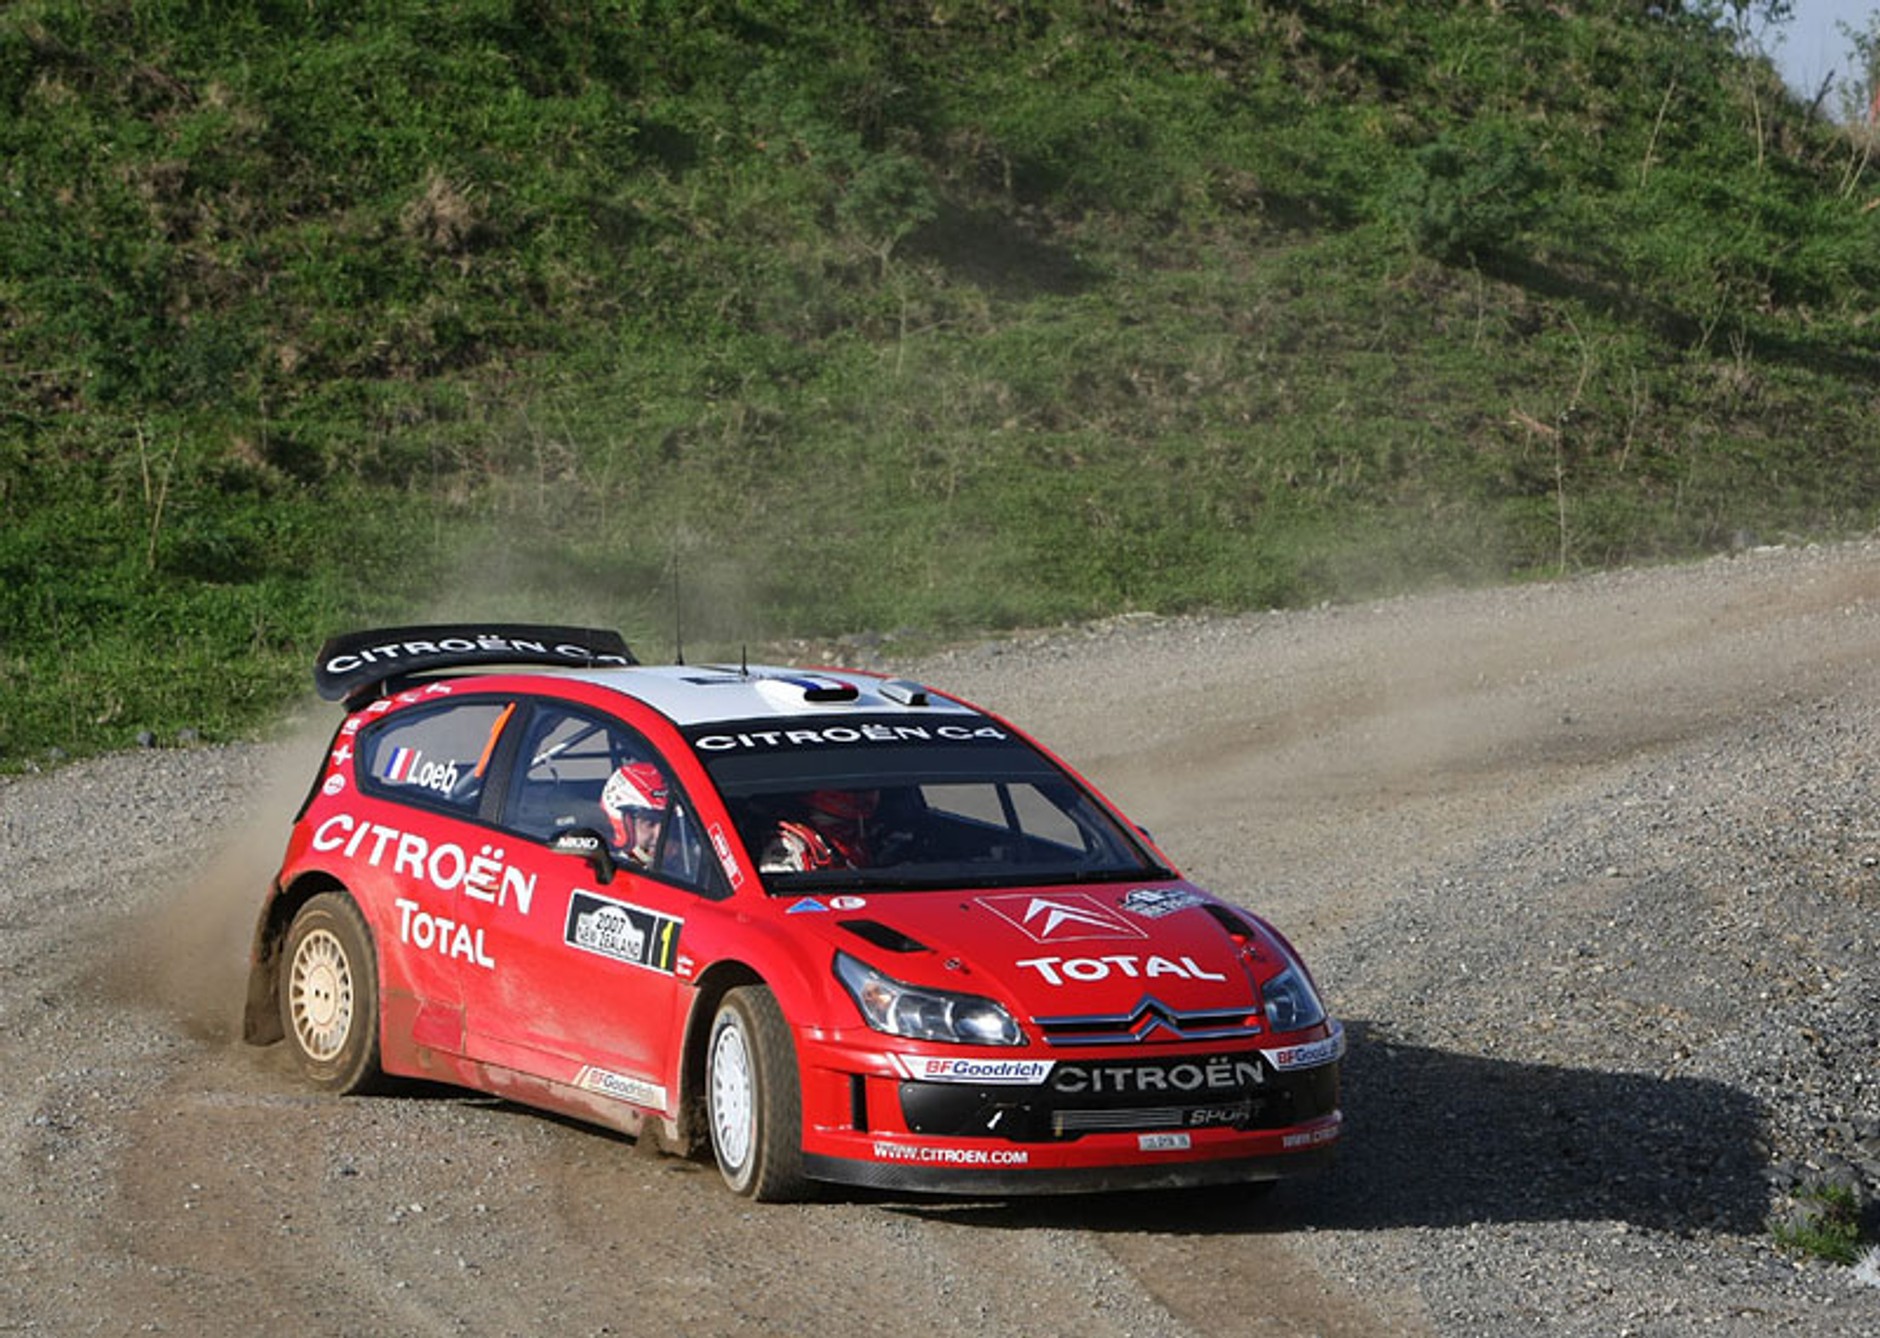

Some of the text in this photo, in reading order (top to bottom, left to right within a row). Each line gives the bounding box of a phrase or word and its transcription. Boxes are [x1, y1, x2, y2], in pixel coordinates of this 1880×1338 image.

[326, 635, 546, 674] CITROËN
[696, 724, 1007, 751] CITROËN C4
[407, 750, 458, 794] Loeb
[312, 814, 538, 915] CITROËN
[596, 912, 626, 935] 2007
[599, 931, 641, 958] ZEALAND
[660, 921, 674, 969] 1
[1015, 955, 1228, 986] TOTAL
[925, 1059, 1045, 1078] BFGoodrich
[1053, 1057, 1265, 1093] CITROËN
